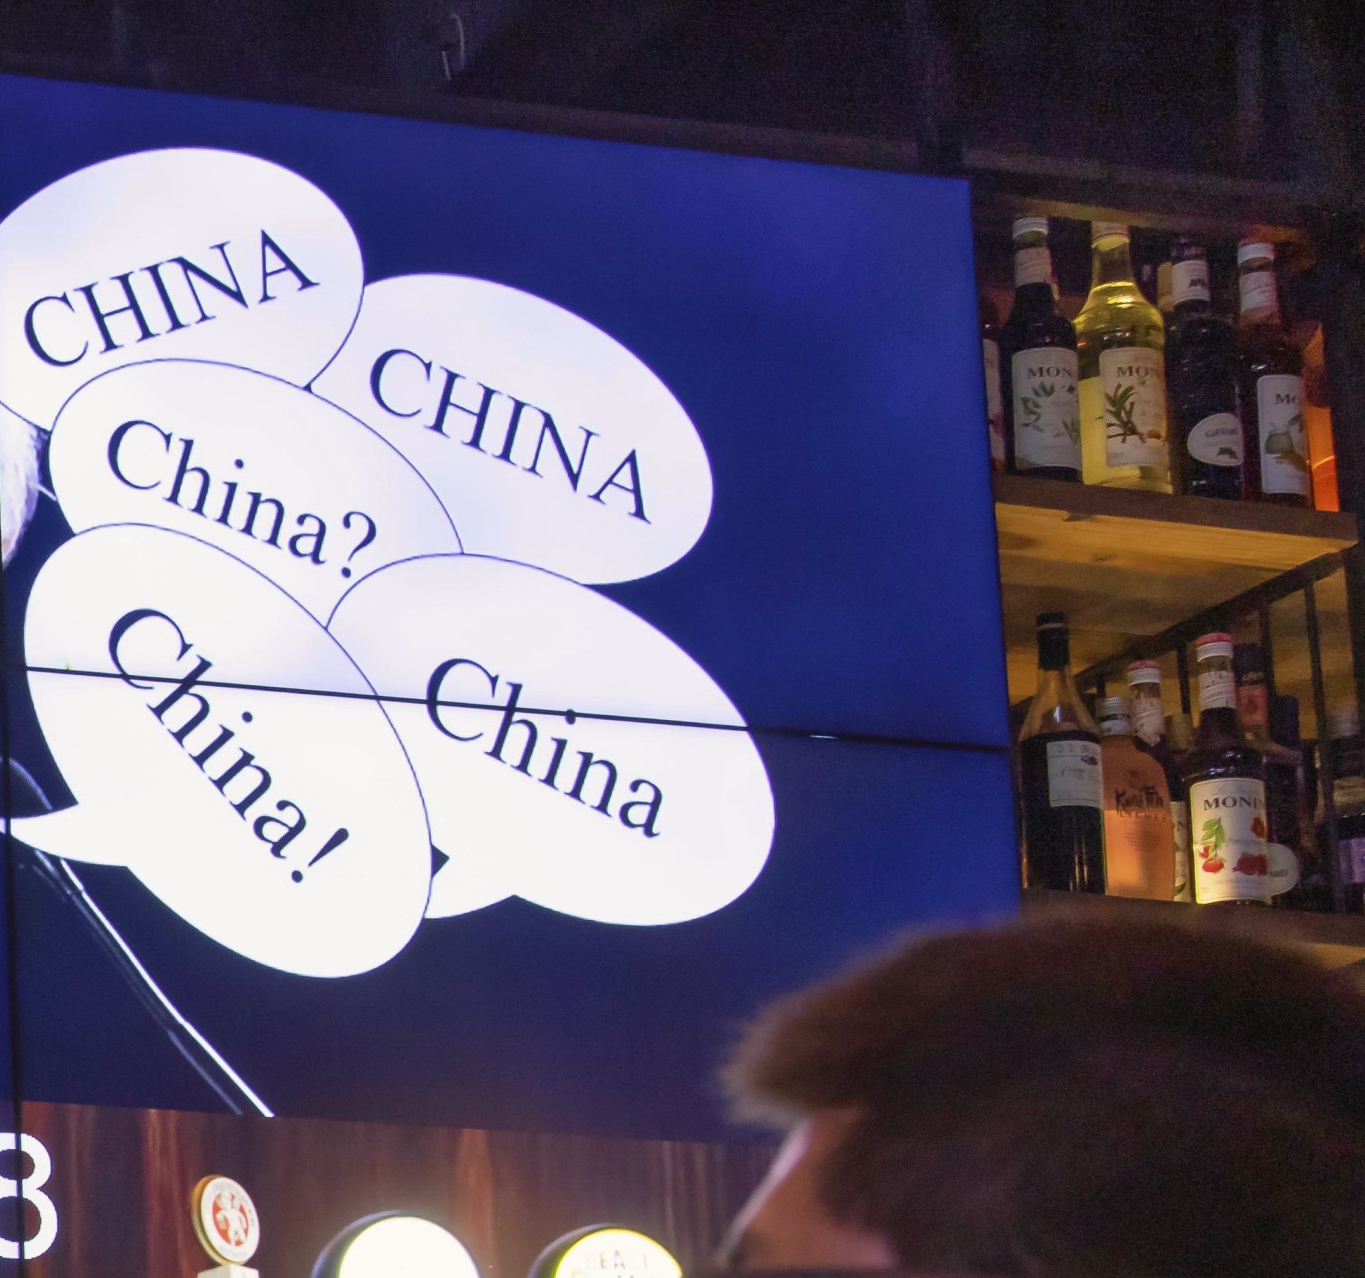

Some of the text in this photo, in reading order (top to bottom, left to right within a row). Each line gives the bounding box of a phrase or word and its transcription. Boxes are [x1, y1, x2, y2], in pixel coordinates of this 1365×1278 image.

[22, 228, 320, 368] CHINA
[106, 418, 379, 580] China?
[369, 347, 653, 525] CHINA
[106, 607, 351, 883] China!
[425, 656, 665, 839] China
